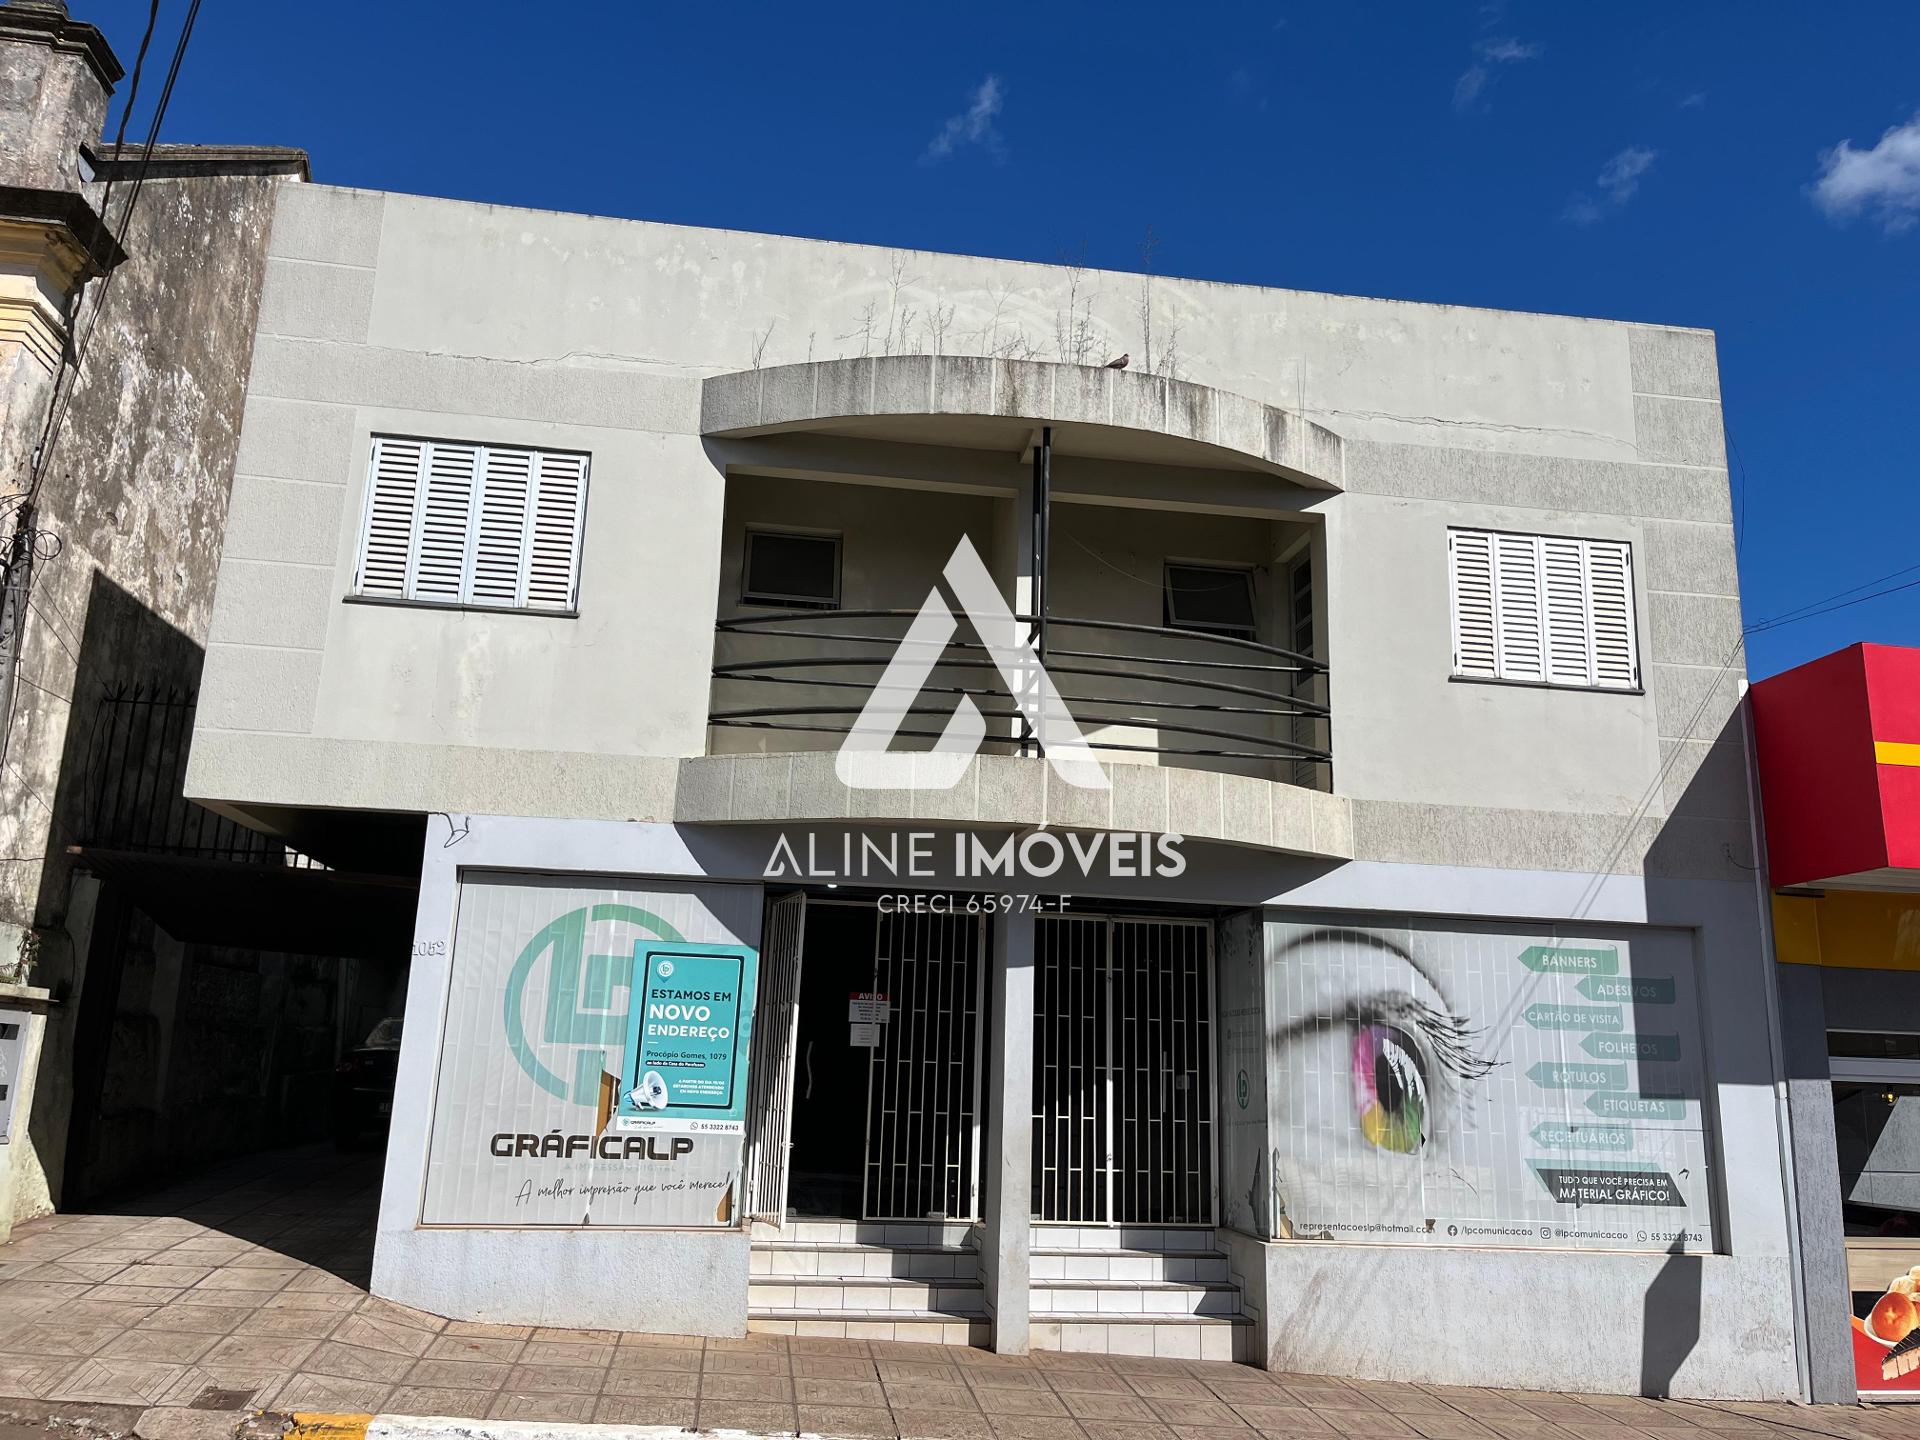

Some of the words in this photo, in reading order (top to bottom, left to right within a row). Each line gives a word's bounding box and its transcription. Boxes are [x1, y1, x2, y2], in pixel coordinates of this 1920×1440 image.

[1542, 954, 1597, 969] BANNERS
[651, 988, 711, 1001] ESTAMOS
[713, 991, 732, 1002] EM
[649, 1003, 711, 1022] NOVO
[1528, 1011, 1571, 1023] CARTÃO
[1573, 1014, 1587, 1024] DE
[1590, 1015, 1620, 1026] VISITA
[647, 1024, 730, 1042] ENDEREÇO
[646, 1049, 679, 1060] Procópio
[680, 1051, 708, 1061] Gomes,
[710, 1052, 727, 1061] 1079
[1603, 1100, 1666, 1113] ETIQUETAS
[490, 1129, 694, 1161] GRÁFICALP
[1581, 1176, 1598, 1185] QUE
[1600, 1176, 1623, 1186] VOCÊ
[1624, 1177, 1655, 1187] PRECISA
[1656, 1178, 1668, 1187] EM
[515, 1179, 533, 1207] A
[537, 1178, 575, 1200] melhor
[579, 1182, 631, 1205] impressão
[634, 1185, 657, 1205] que
[661, 1180, 686, 1192] você
[1559, 1187, 1613, 1200] MATERIAL
[1615, 1186, 1670, 1201] GRÁFICO!
[1650, 1232, 1660, 1241] 55
